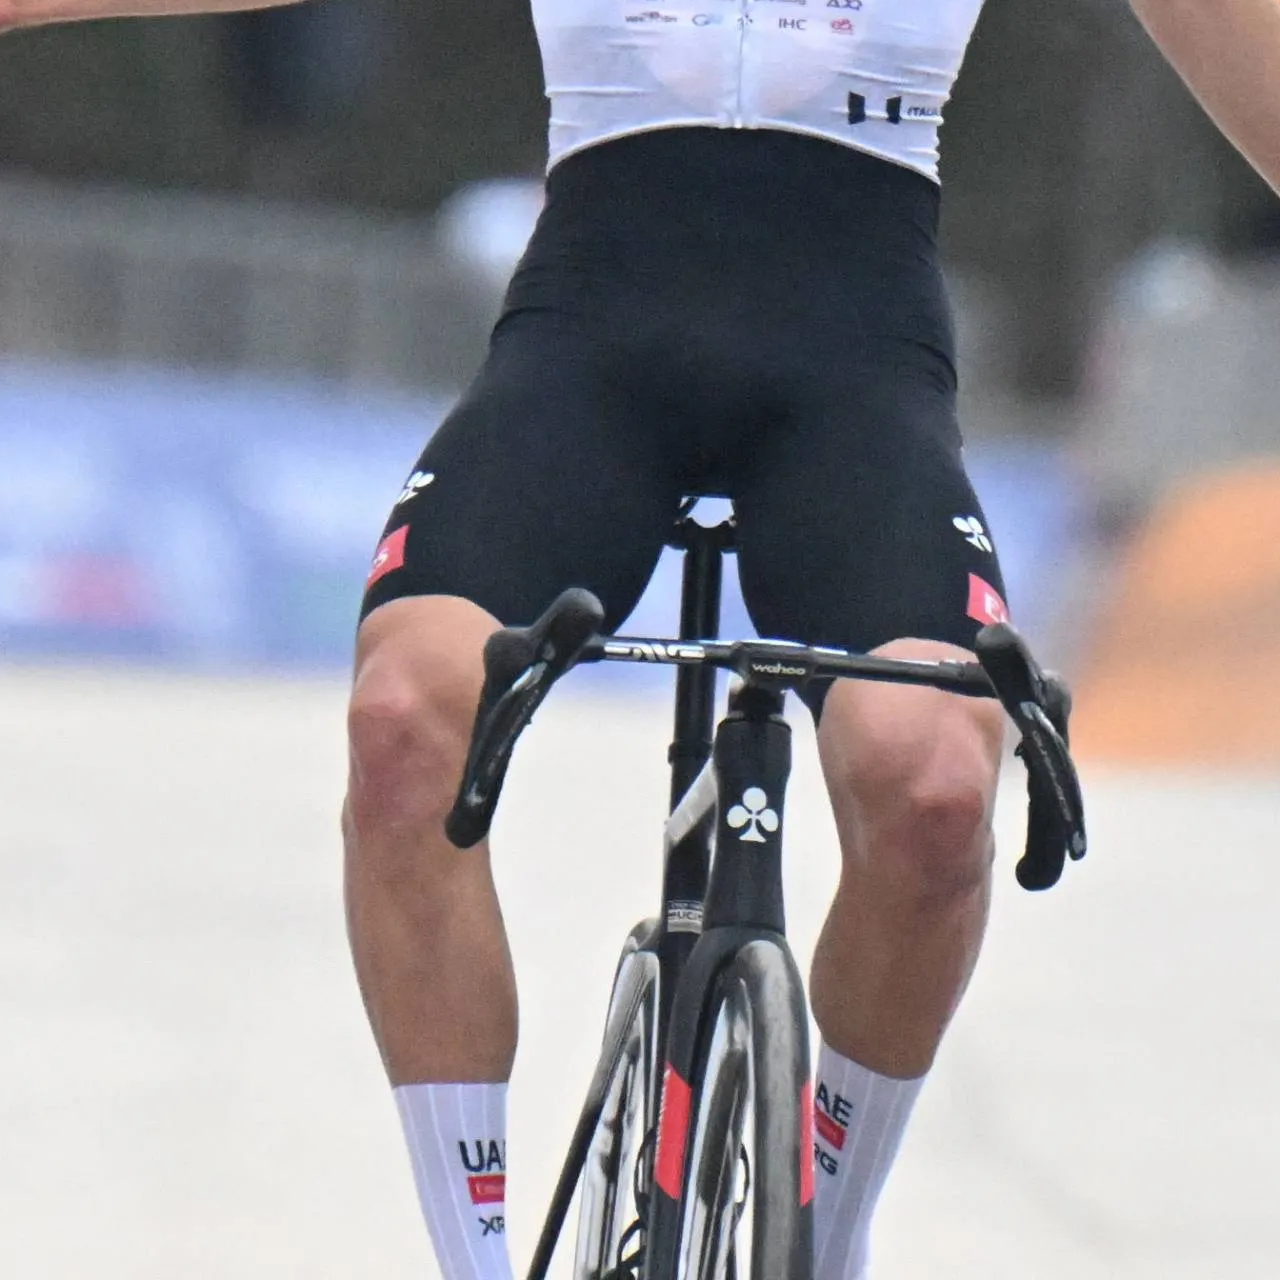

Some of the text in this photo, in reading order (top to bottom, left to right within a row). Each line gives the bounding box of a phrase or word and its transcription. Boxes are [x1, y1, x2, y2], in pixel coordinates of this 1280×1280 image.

[778, 18, 808, 31] IHC
[752, 663, 807, 676] wahoo
[816, 1080, 853, 1128] AE
[458, 1139, 506, 1173] UA
